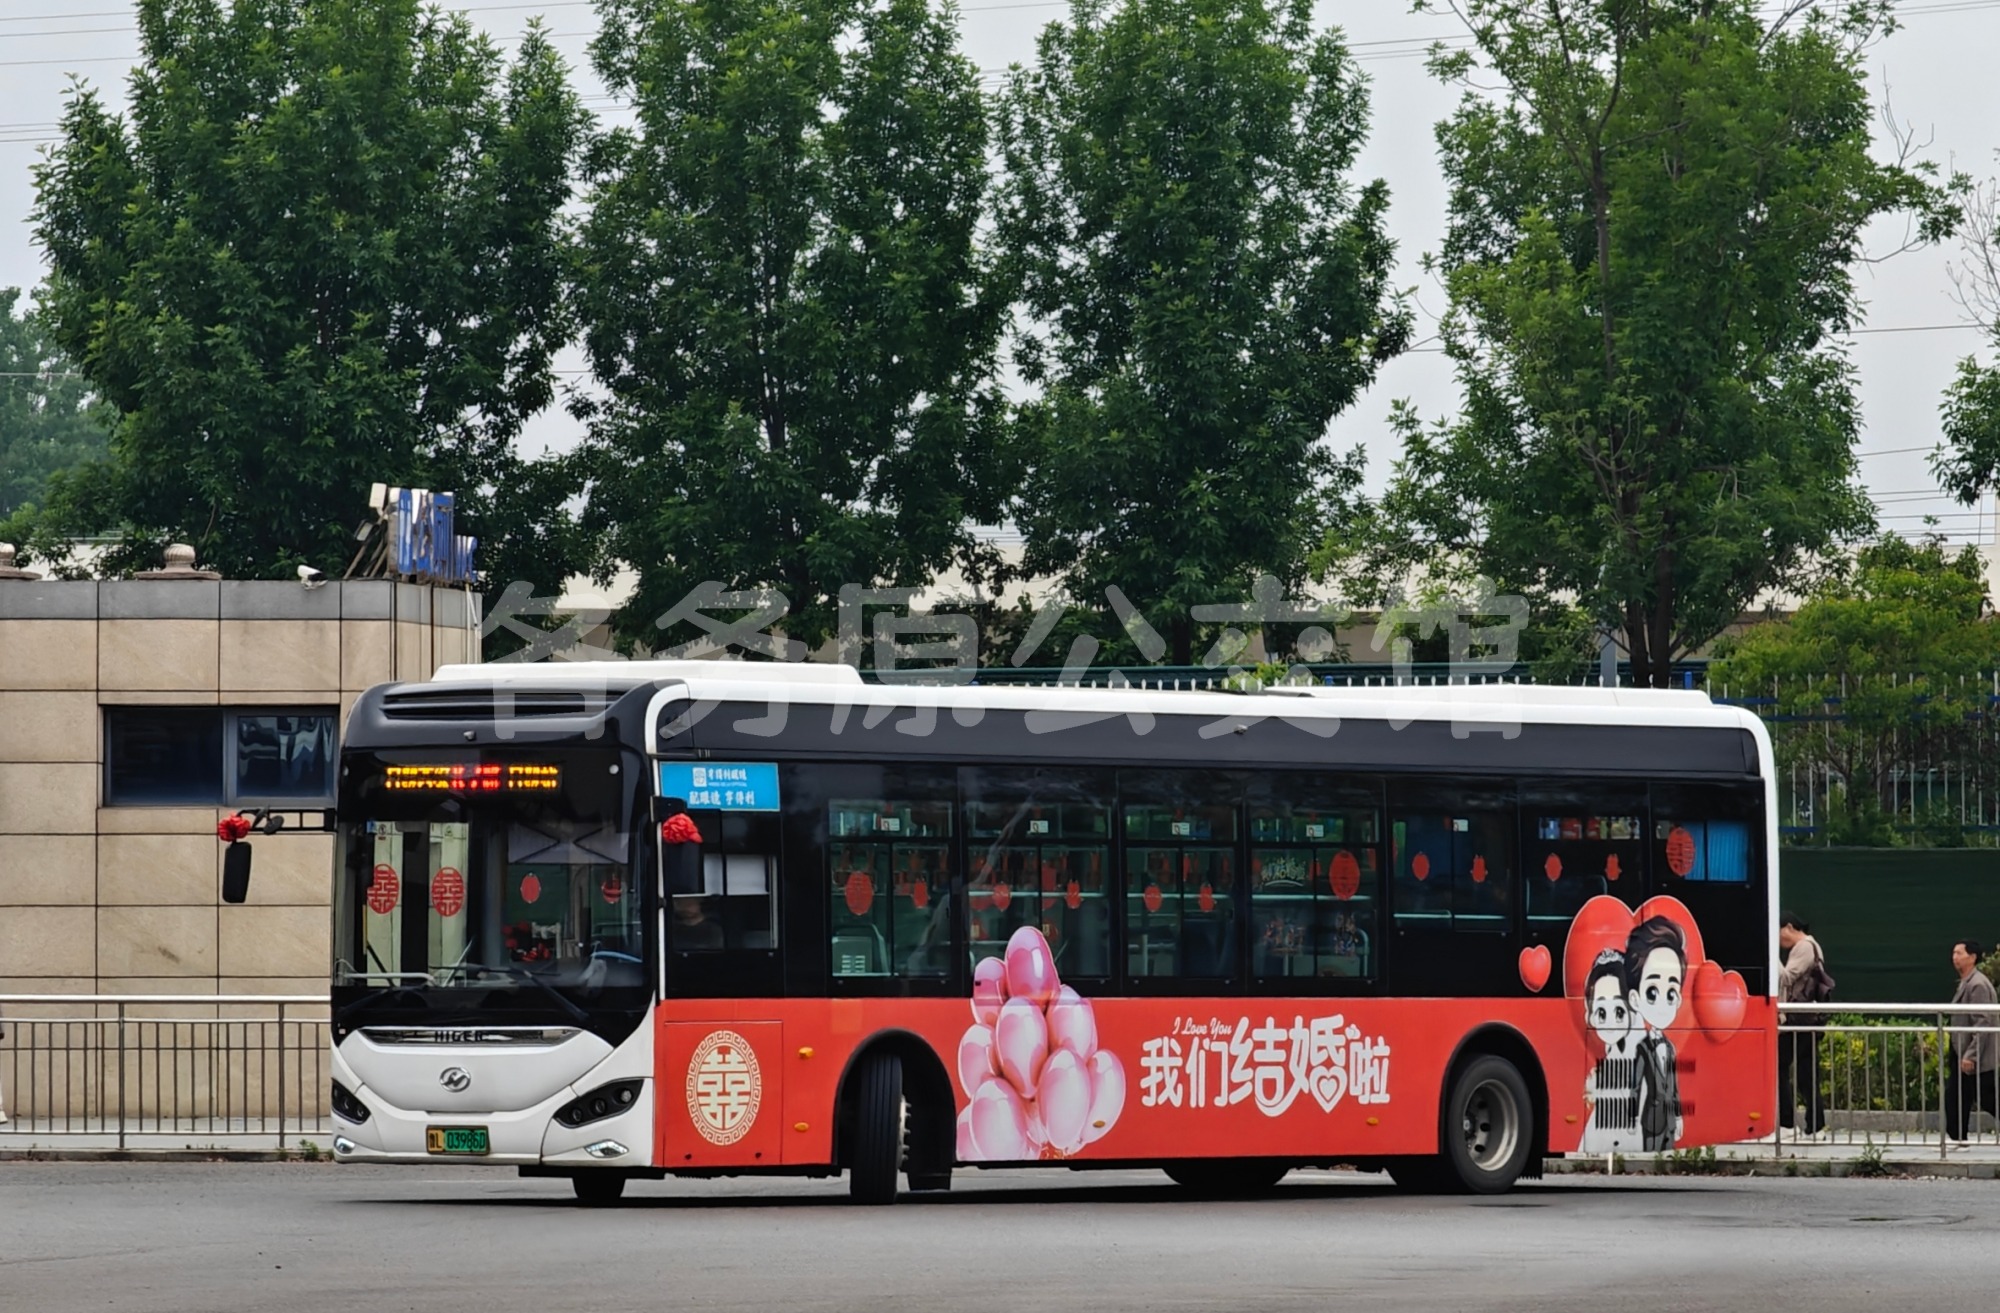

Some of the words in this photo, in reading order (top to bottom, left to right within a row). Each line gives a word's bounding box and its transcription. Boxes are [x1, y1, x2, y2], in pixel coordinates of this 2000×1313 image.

[434, 1030, 483, 1043] HIGER
[1172, 1017, 1181, 1035] I
[1181, 1017, 1208, 1035] Love
[1210, 1017, 1232, 1041] You
[1140, 1014, 1390, 1117] 我们结婚啦
